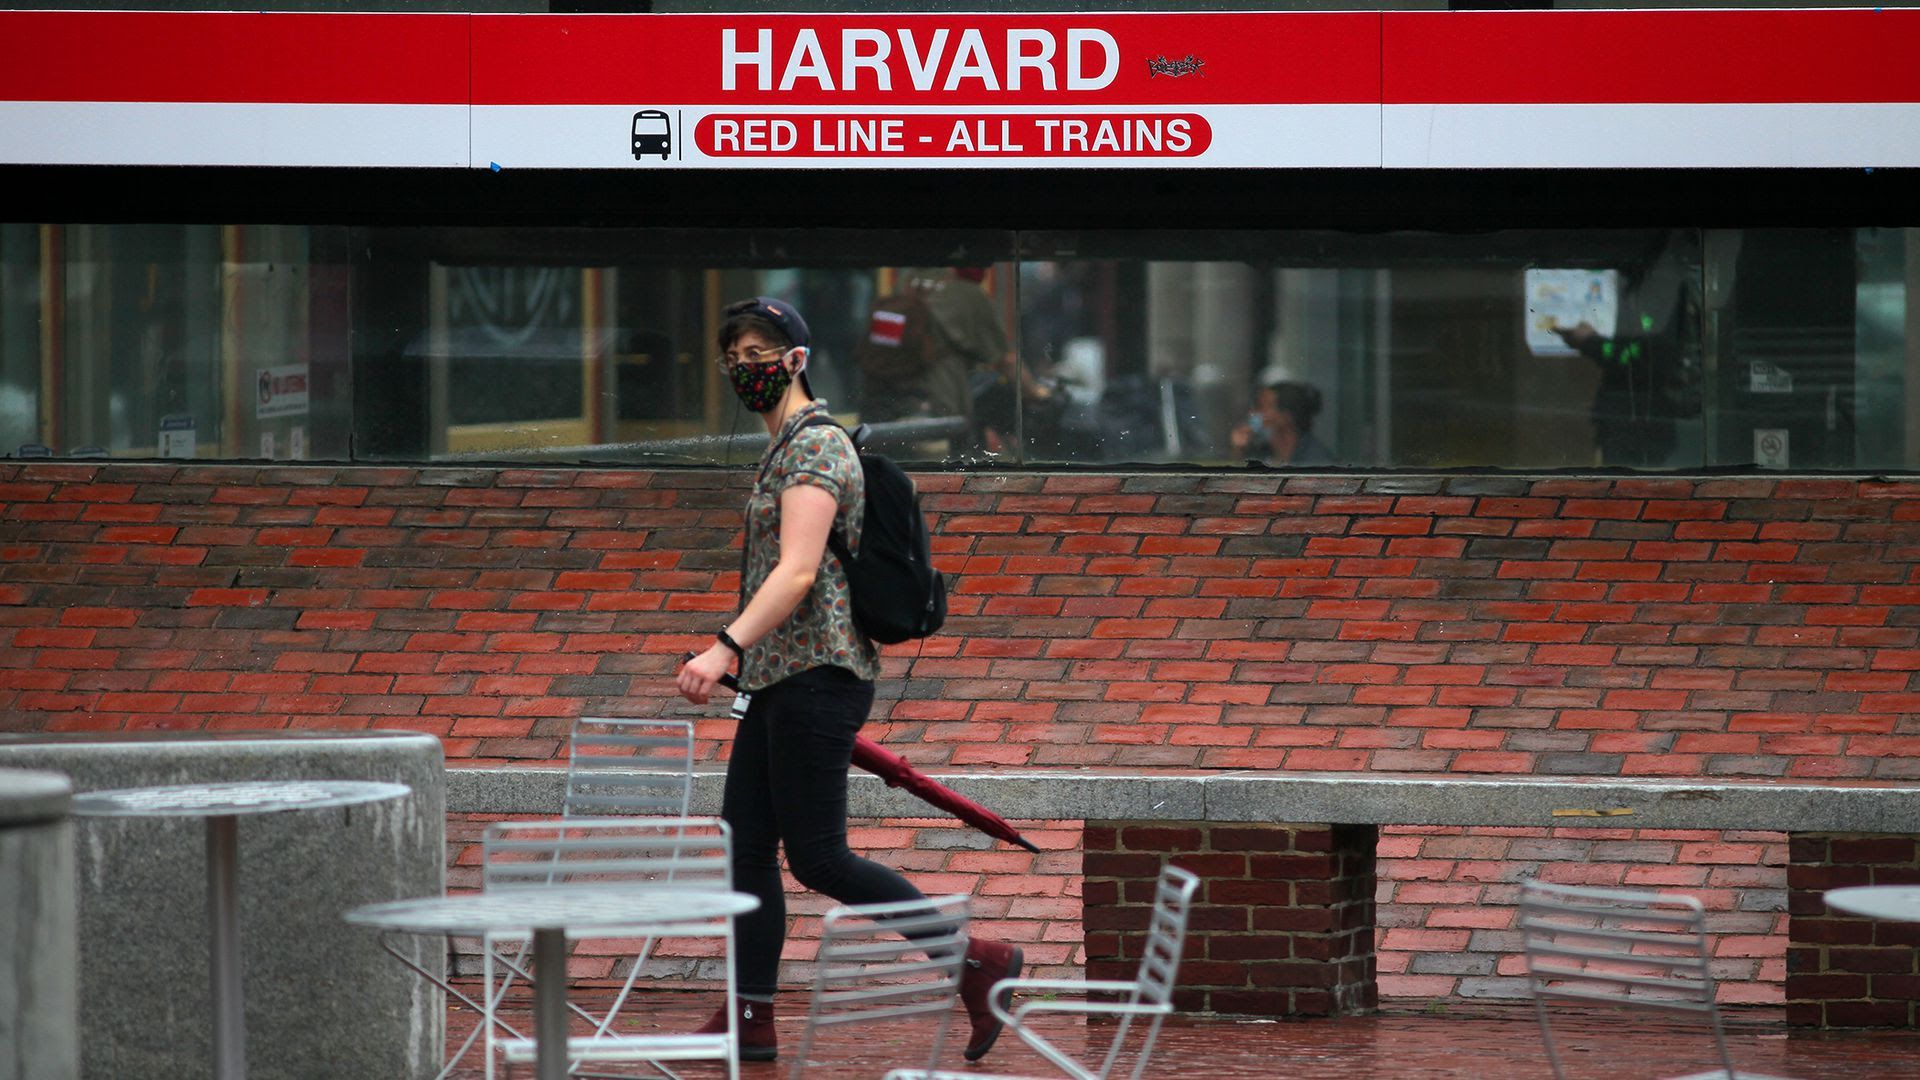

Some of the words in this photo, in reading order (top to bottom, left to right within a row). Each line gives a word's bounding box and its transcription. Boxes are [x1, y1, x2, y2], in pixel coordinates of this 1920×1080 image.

[721, 28, 1120, 92] HARVARD
[714, 119, 798, 152] RED
[813, 119, 905, 152] LINE
[945, 119, 1024, 152] ALL
[1035, 118, 1192, 153] TRAINS
